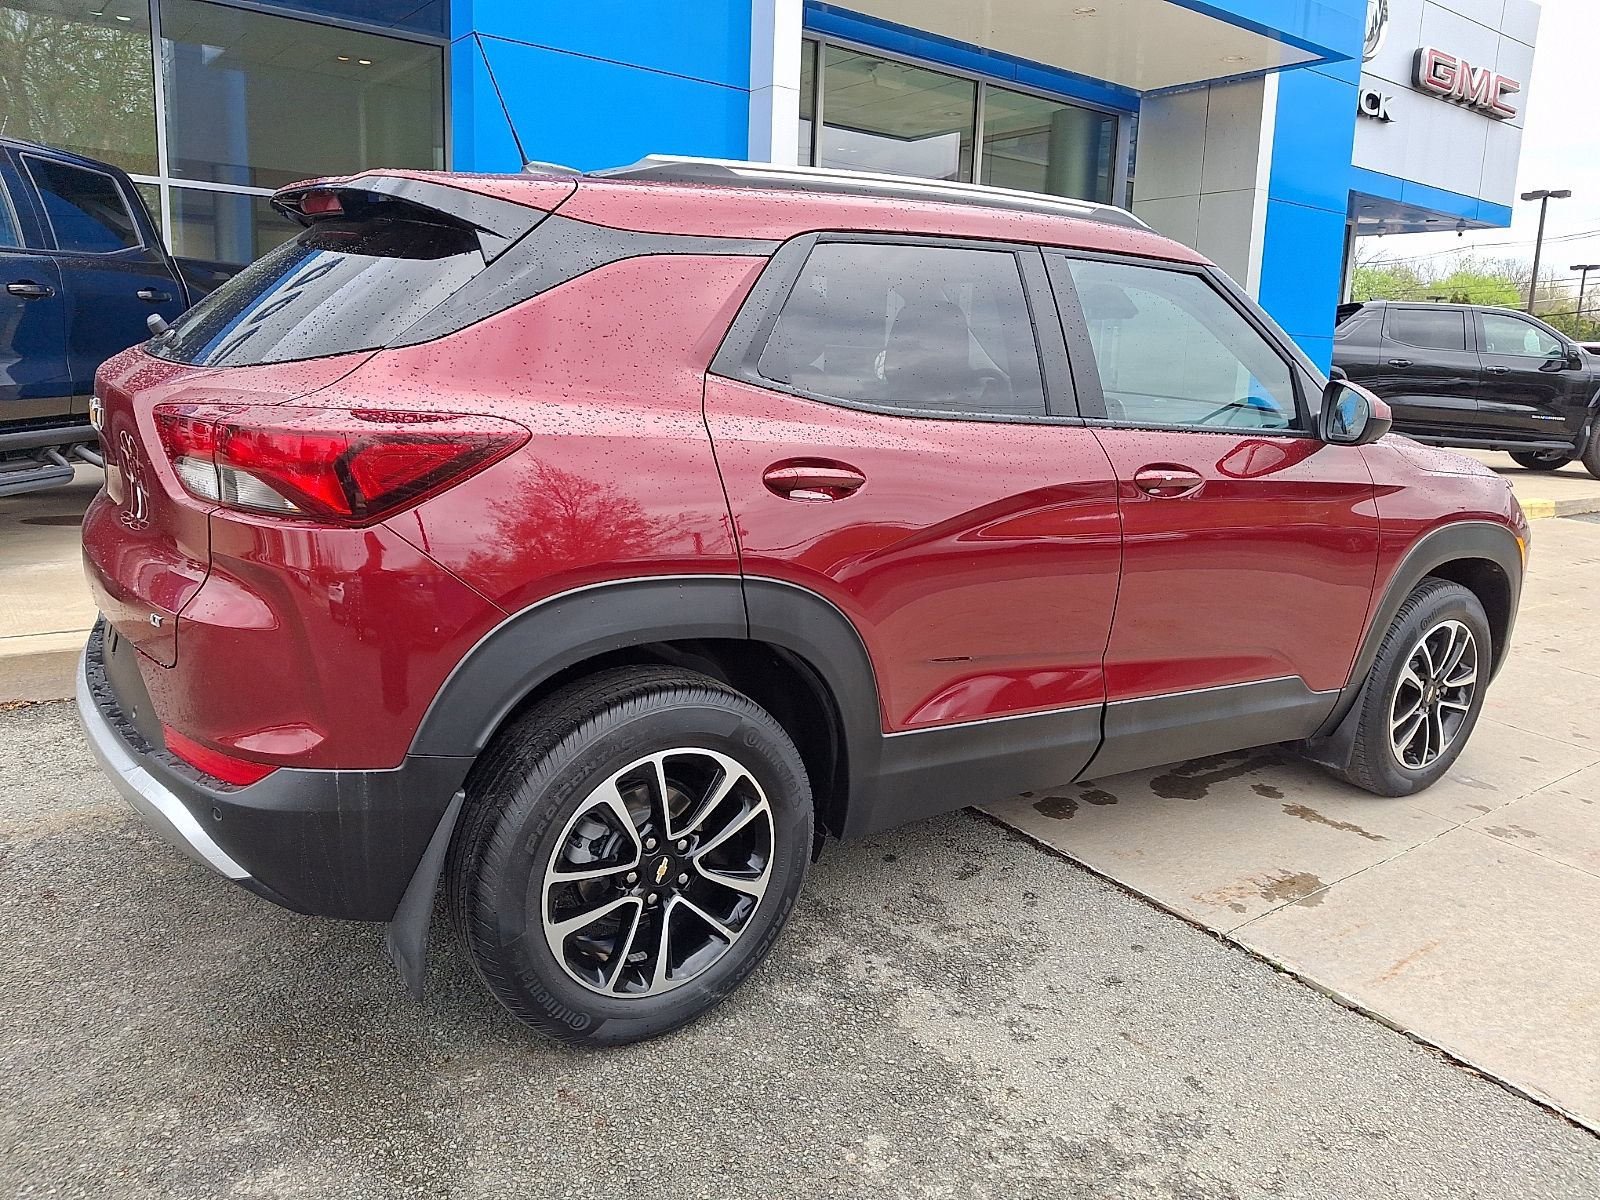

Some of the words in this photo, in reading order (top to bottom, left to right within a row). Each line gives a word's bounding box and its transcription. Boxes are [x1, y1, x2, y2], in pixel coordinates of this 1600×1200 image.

[1359, 88, 1394, 122] CK
[1413, 47, 1521, 119] GMC
[516, 967, 591, 1031] Continental
